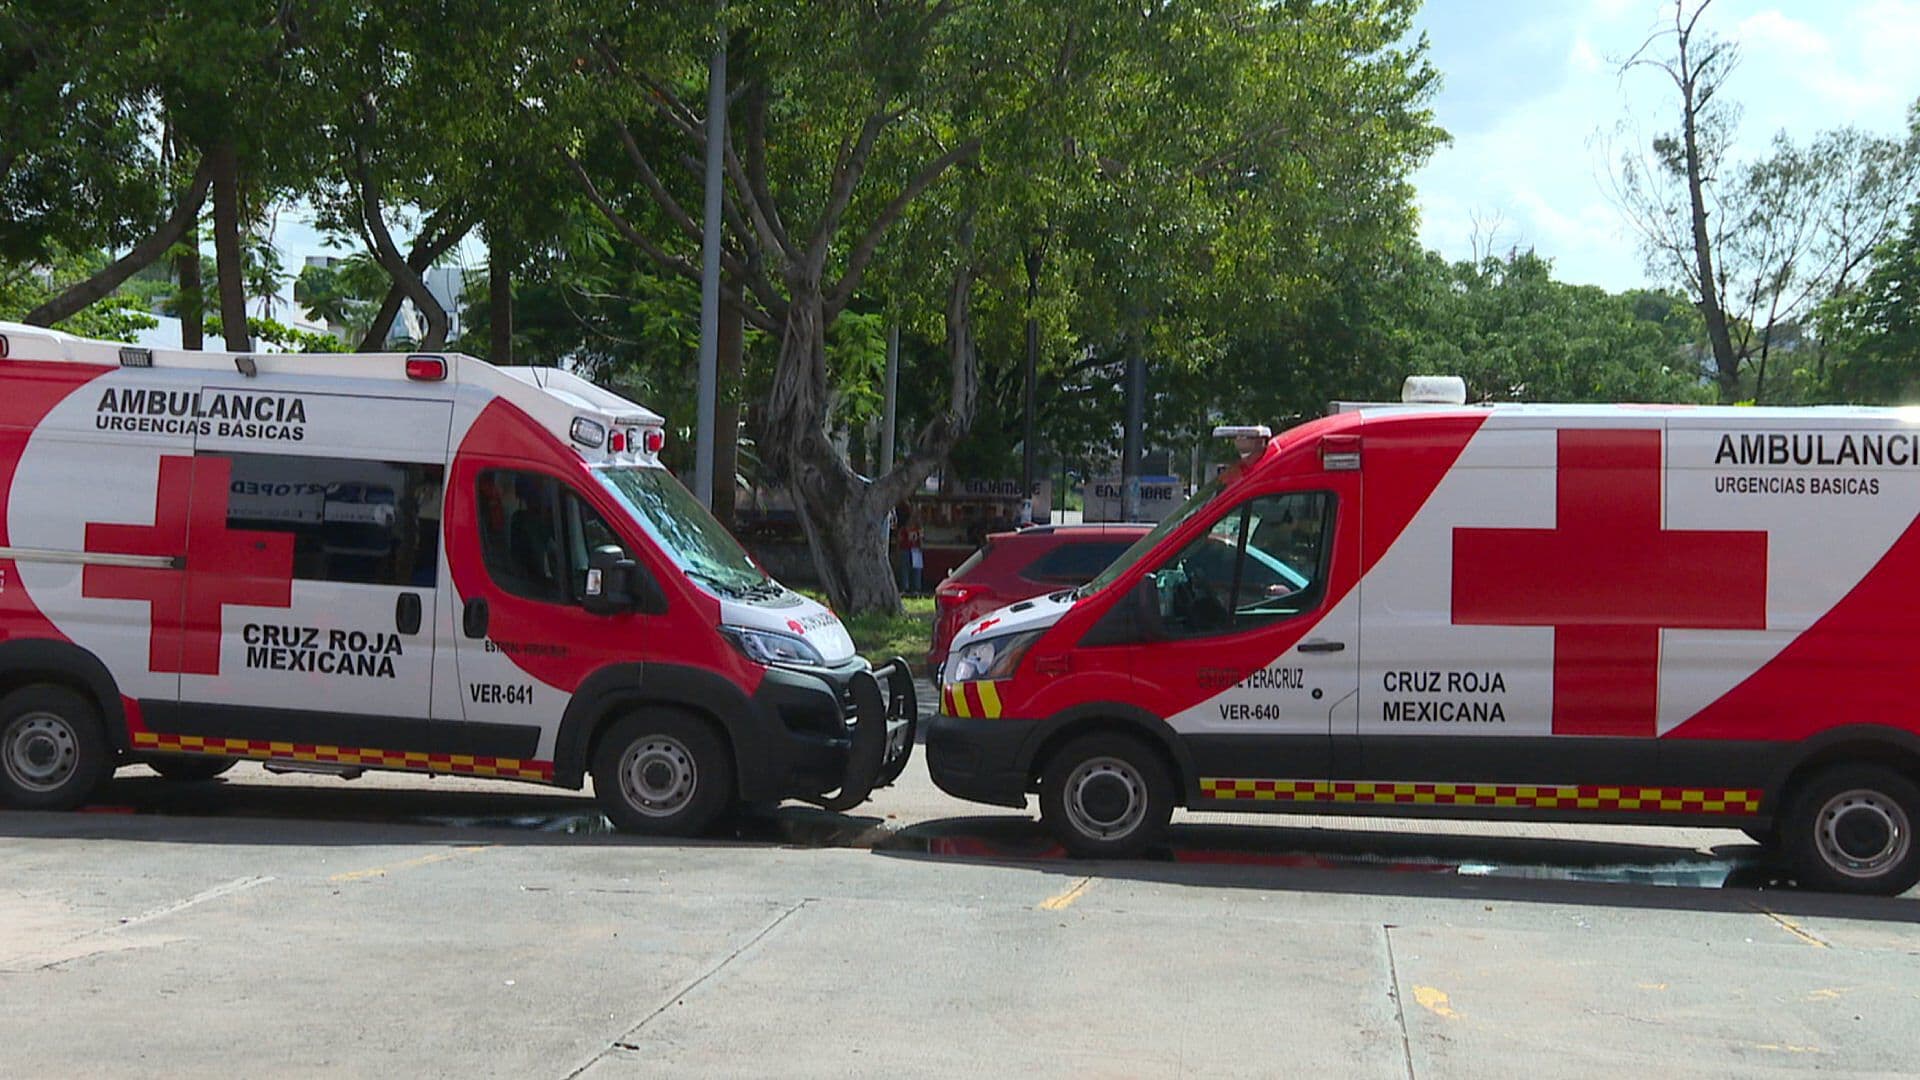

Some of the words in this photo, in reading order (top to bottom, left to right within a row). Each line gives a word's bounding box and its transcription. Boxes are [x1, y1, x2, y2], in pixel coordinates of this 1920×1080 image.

[97, 388, 306, 423] AMBULANCIA
[96, 415, 211, 435] URGENCIAS
[1714, 434, 1920, 466] AMBULANCI
[1095, 484, 1173, 500] ENJBRE
[1715, 477, 1805, 494] URGENCIAS
[1810, 478, 1880, 495] BASICAS
[243, 623, 319, 649] CRUZ
[329, 629, 403, 656] ROJA
[246, 646, 396, 679] MEXICANA
[1244, 668, 1304, 689] VERACRUZ
[1383, 671, 1441, 692] CRUZ
[1447, 672, 1506, 693] ROJA
[1383, 702, 1506, 722] MEXICANA
